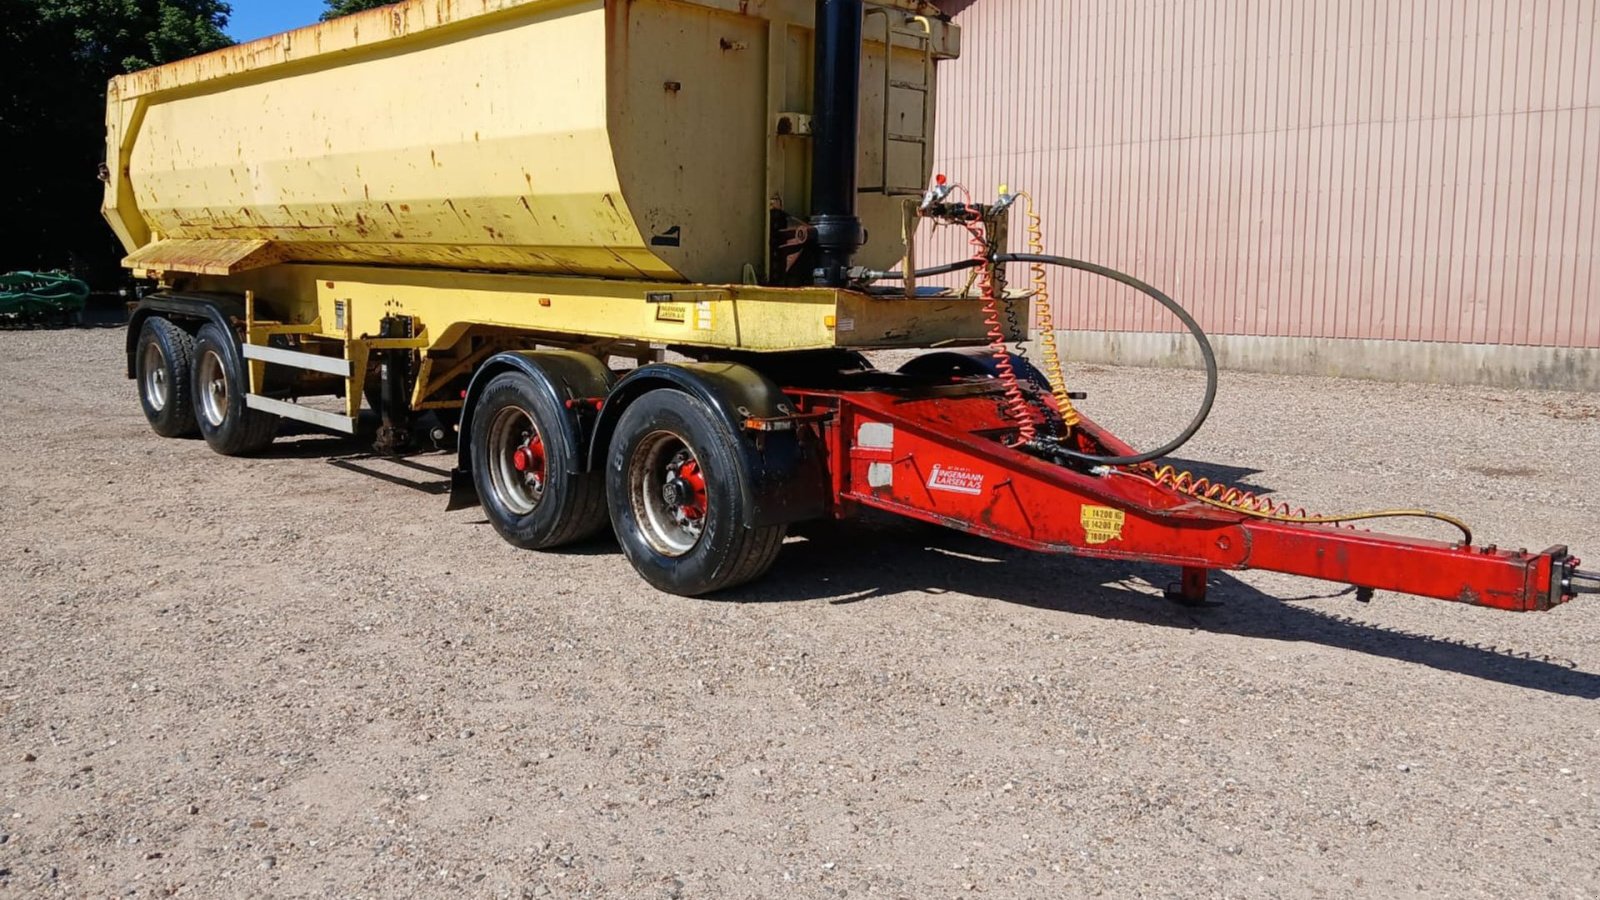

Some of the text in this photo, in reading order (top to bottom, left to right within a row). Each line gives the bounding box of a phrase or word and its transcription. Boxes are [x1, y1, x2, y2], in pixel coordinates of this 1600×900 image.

[938, 469, 984, 481] INGEMANN
[936, 477, 982, 489] LARSEN A/S
[1092, 509, 1113, 518] 14200
